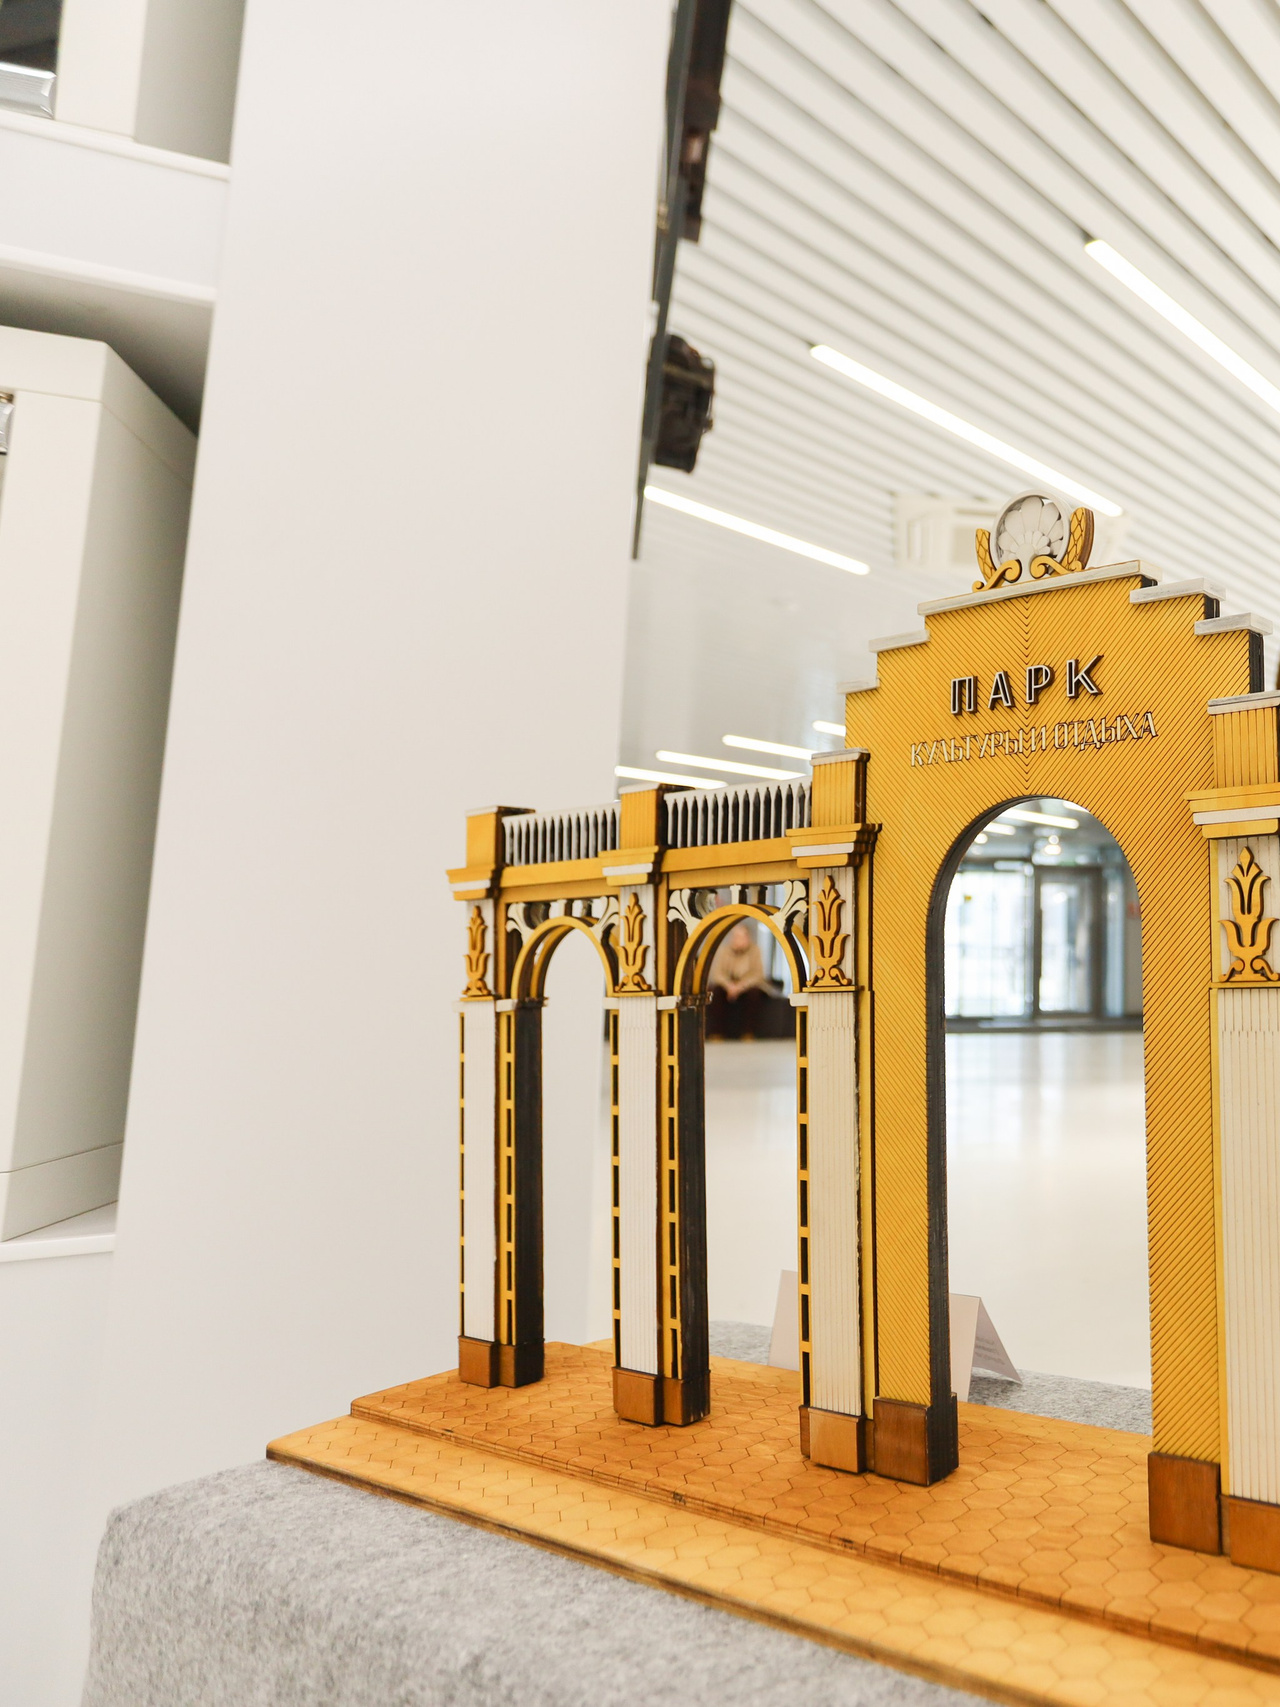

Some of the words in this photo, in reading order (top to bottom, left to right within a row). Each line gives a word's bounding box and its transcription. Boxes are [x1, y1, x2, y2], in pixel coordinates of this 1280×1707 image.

[950, 655, 1104, 715] ПАРК
[911, 728, 1024, 767] КУЛЬТУРЫ
[1031, 725, 1047, 752] И
[1054, 711, 1158, 751] ОТДЫХА
